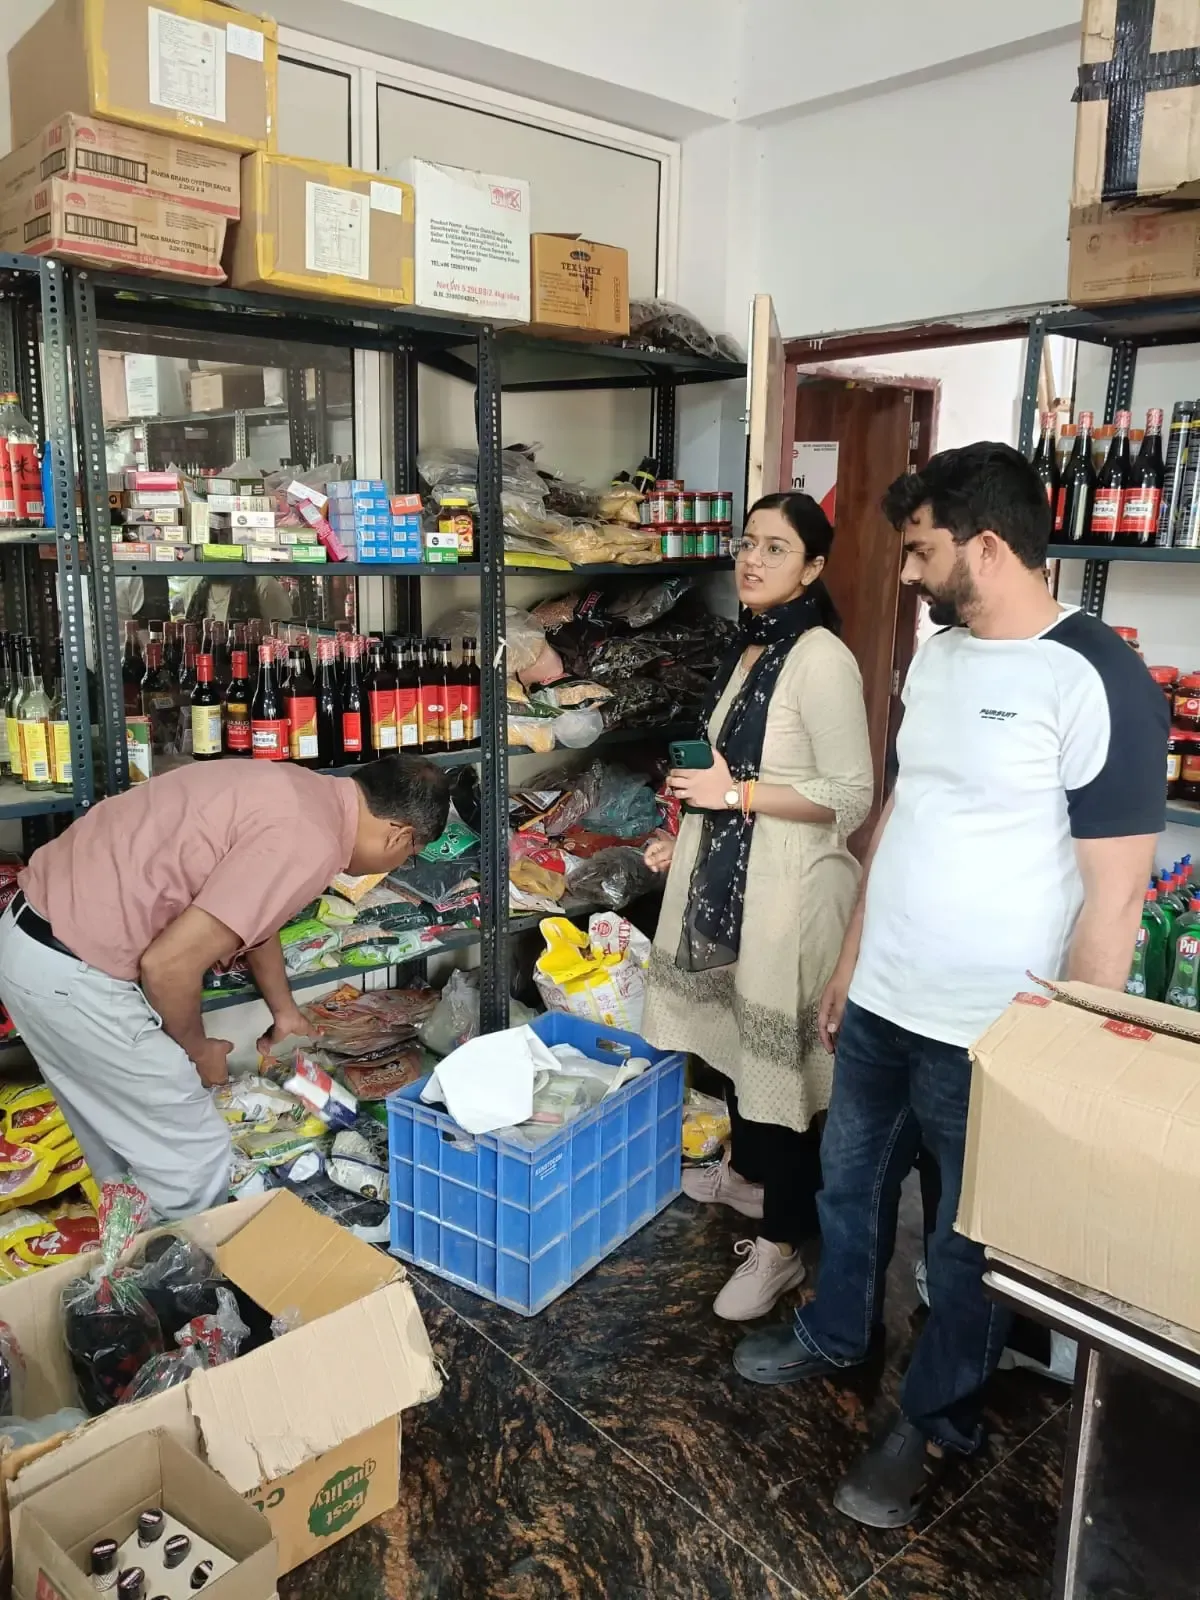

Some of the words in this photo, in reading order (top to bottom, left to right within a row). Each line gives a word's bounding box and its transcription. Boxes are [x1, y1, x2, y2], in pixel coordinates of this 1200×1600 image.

[151, 170, 169, 178] PANDA
[170, 174, 190, 184] BRAND
[190, 178, 212, 189] OYSTER
[213, 182, 231, 192] SAUCE
[140, 232, 160, 241] PANDA
[161, 236, 180, 245] BRAND
[181, 239, 202, 249] OYSTER
[561, 262, 577, 271] TEX
[979, 708, 1018, 719] PURSUIT
[1180, 939, 1198, 954] Pril
[313, 1457, 376, 1510] quality
[325, 1490, 365, 1526] Best
